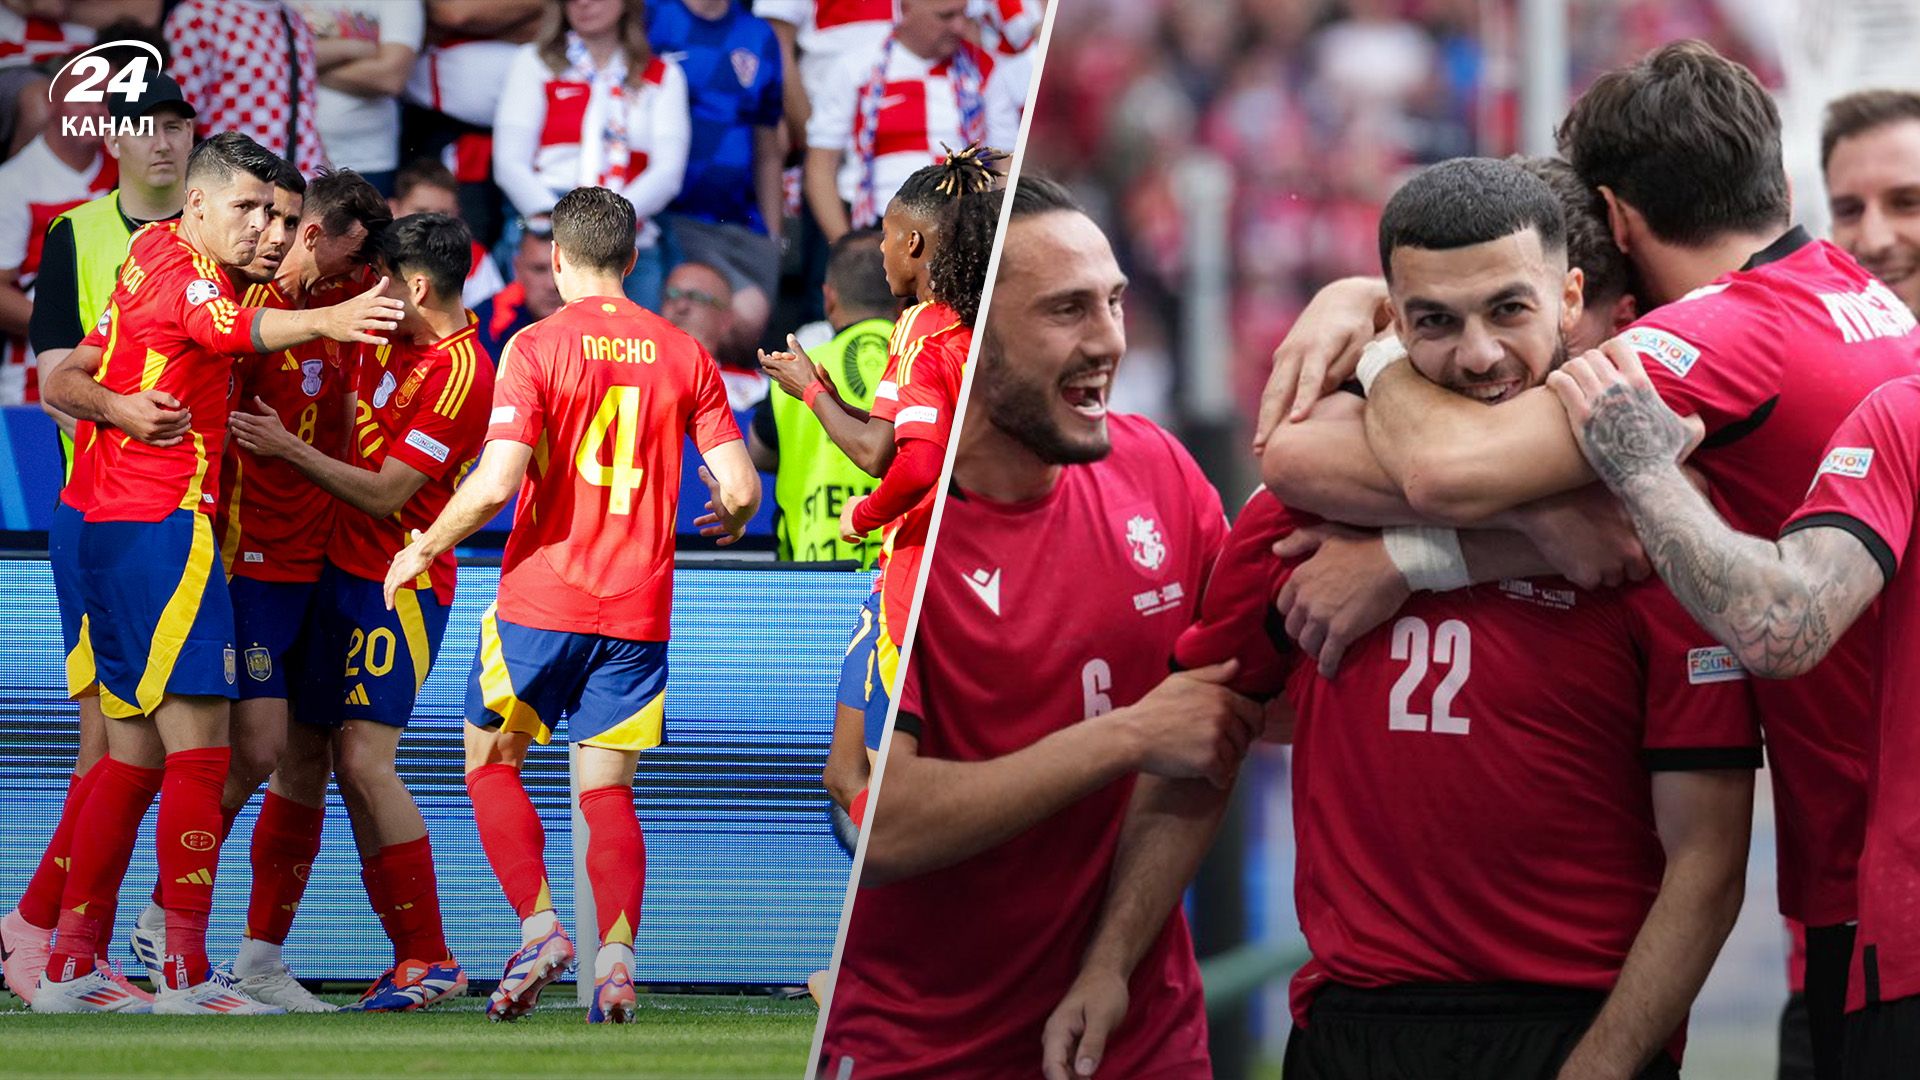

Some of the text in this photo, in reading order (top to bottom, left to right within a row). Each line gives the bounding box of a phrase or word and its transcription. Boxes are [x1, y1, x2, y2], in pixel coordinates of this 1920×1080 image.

[582, 334, 656, 365] NACHO
[297, 402, 318, 446] 8
[575, 385, 644, 516] 4
[344, 626, 397, 677] 20
[1388, 615, 1472, 735] 22
